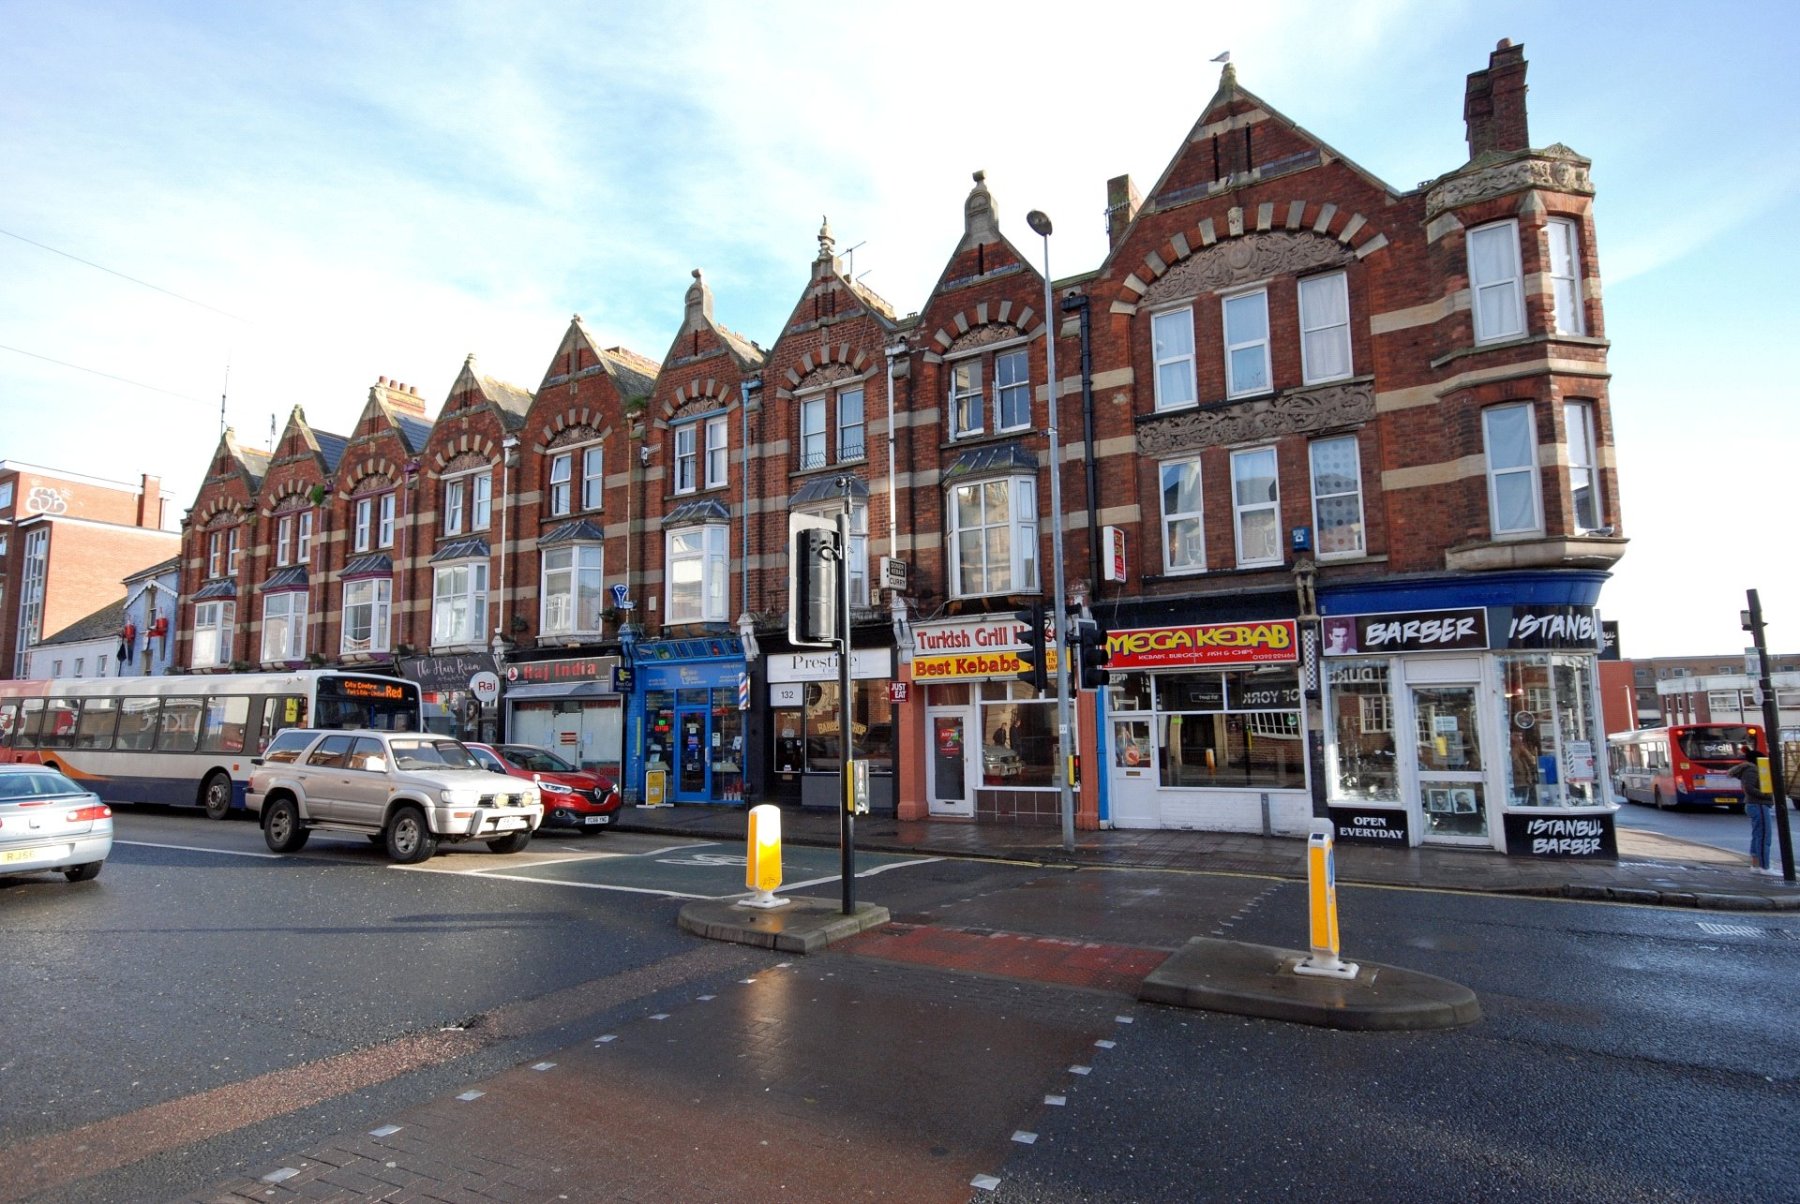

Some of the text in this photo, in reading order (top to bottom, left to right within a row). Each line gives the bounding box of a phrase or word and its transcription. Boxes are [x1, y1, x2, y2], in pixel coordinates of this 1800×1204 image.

[917, 628, 971, 650] Turkish
[974, 626, 1008, 647] Grill
[1365, 616, 1478, 646] BARBER
[1106, 624, 1290, 659] MEGA KEBAB
[523, 660, 597, 682] Raj India
[915, 654, 1021, 677] Best Kebabs
[385, 684, 402, 698] Red
[478, 680, 496, 692] Raj
[892, 683, 906, 691] JUST
[781, 691, 794, 699] 132
[894, 691, 906, 699] EAT
[1353, 816, 1387, 827] OPEN
[1527, 819, 1603, 836] ISTANBUL
[1339, 827, 1404, 839] EVERYDAY
[1532, 837, 1602, 855] BARBER
